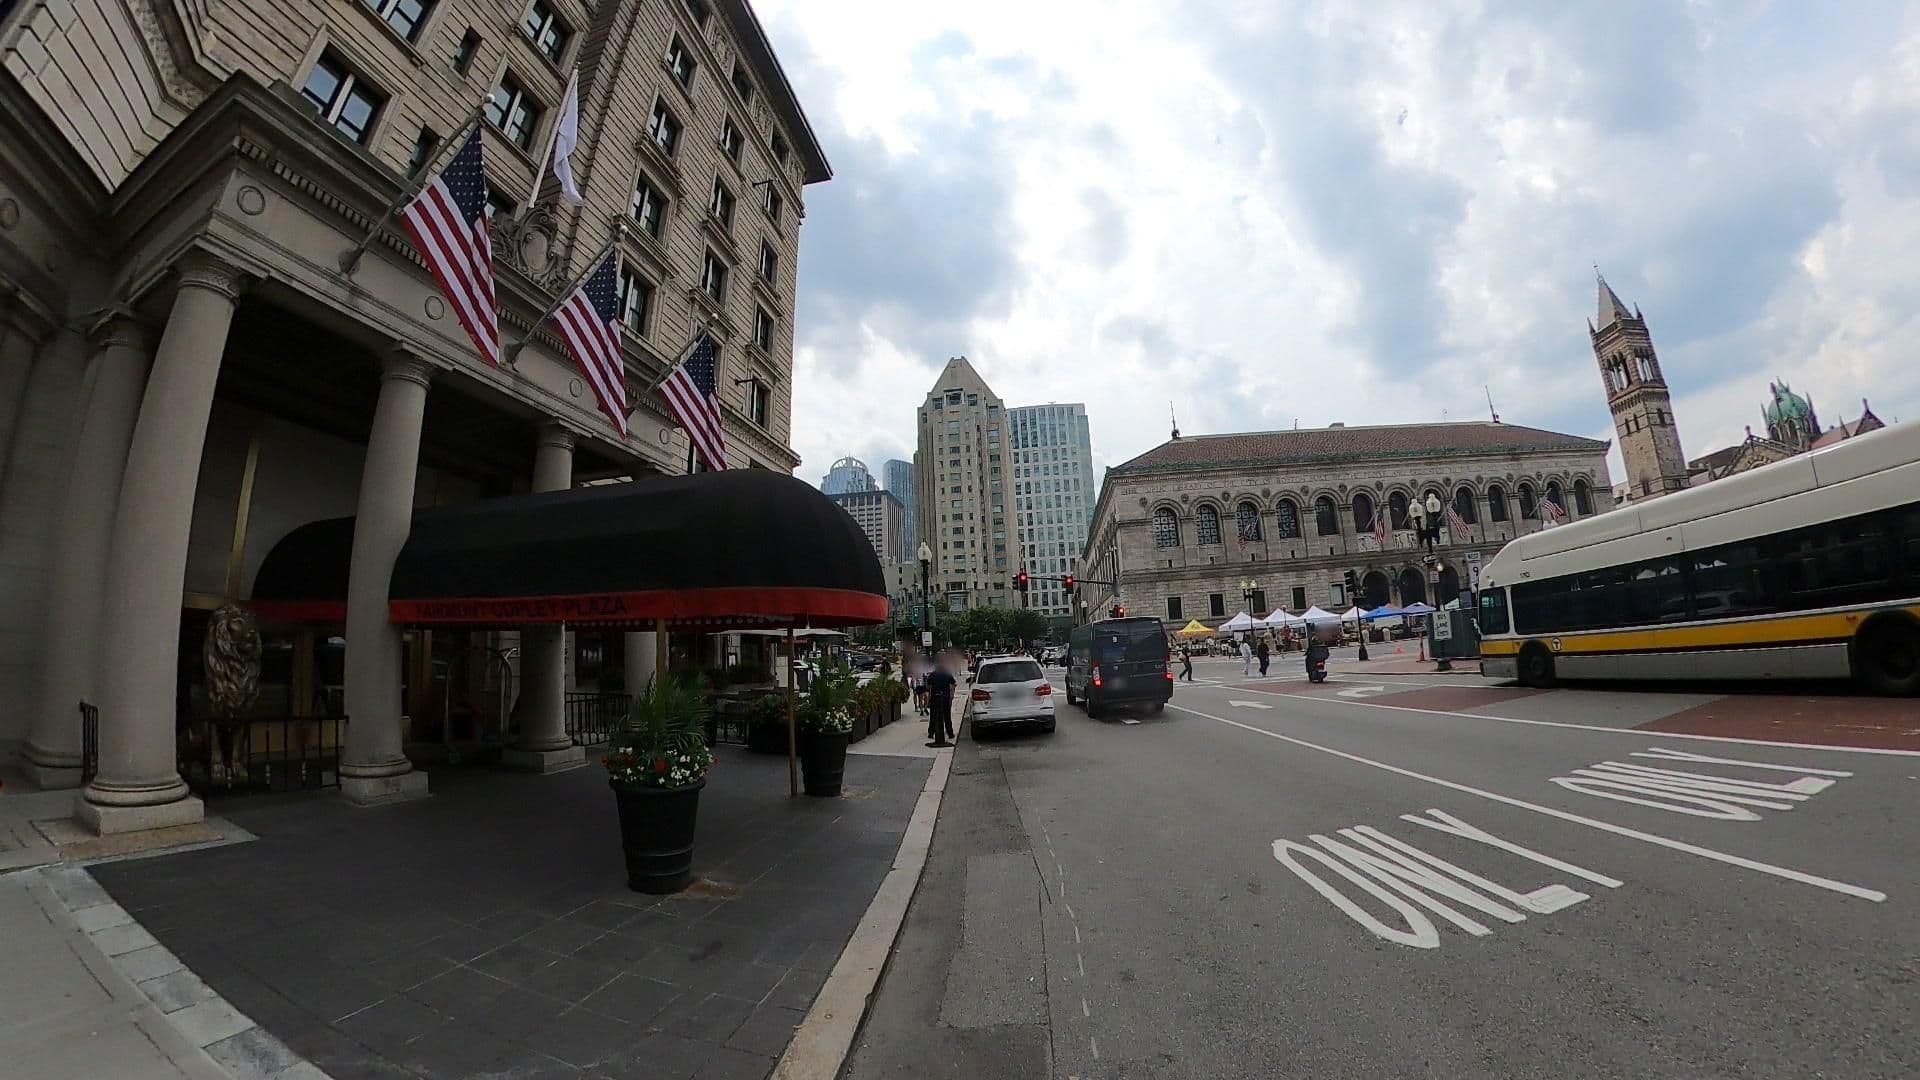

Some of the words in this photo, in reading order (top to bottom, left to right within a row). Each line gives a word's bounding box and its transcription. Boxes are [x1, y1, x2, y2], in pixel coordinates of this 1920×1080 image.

[564, 595, 628, 615] PLAZA
[1548, 747, 1854, 821] ONLY
[1272, 808, 1624, 949] ONLY
